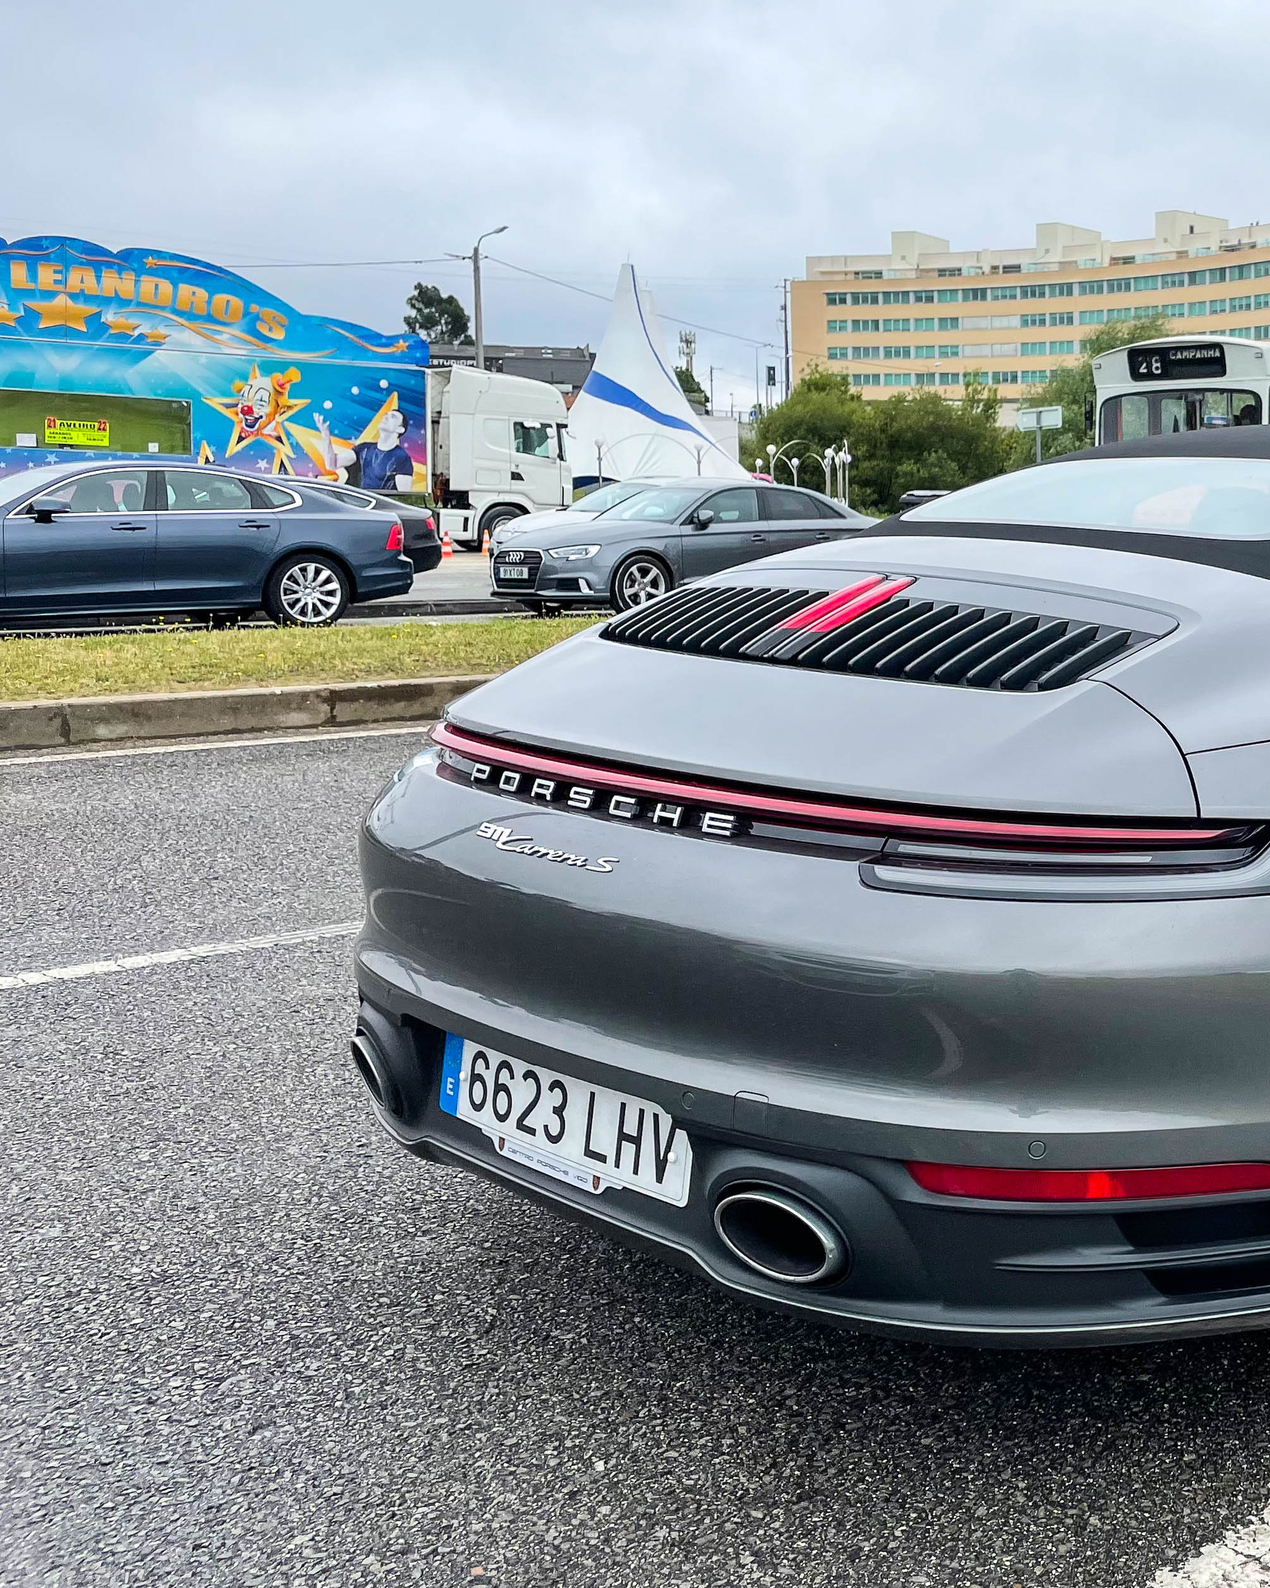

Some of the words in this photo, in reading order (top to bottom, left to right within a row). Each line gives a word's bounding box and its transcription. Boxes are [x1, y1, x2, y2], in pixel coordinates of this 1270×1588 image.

[10, 260, 289, 340] LEANDRO'S
[1169, 348, 1221, 360] CAMPANHA
[471, 763, 738, 837] PORSCHE
[476, 822, 513, 842] 911
[495, 835, 588, 867] Carrera
[584, 857, 620, 873] S
[446, 1077, 455, 1096] E
[468, 1050, 568, 1144] 6623
[583, 1091, 678, 1185] LHV
